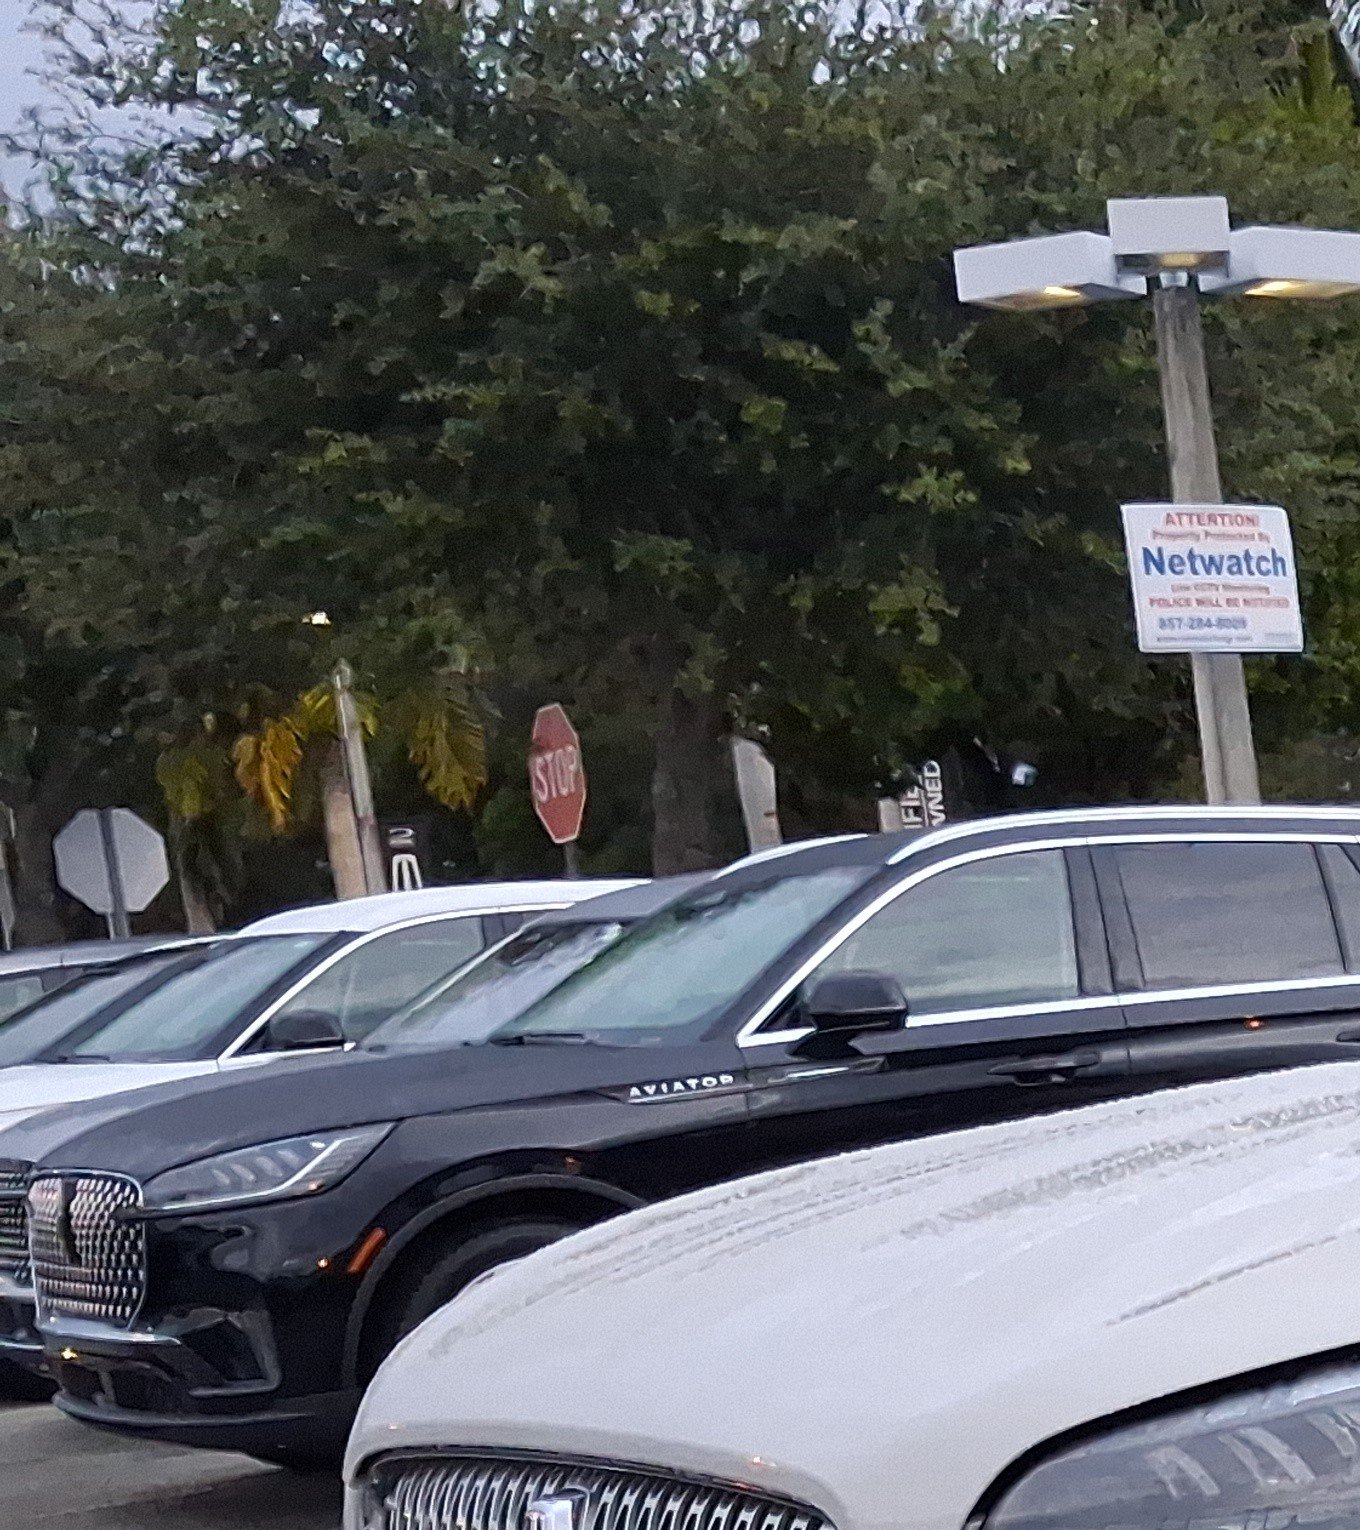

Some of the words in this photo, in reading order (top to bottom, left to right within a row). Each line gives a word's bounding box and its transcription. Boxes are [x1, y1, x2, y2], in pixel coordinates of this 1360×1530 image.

[1142, 546, 1287, 577] Netwatch
[532, 744, 577, 804] STOP
[629, 1073, 734, 1098] AVIATOR
